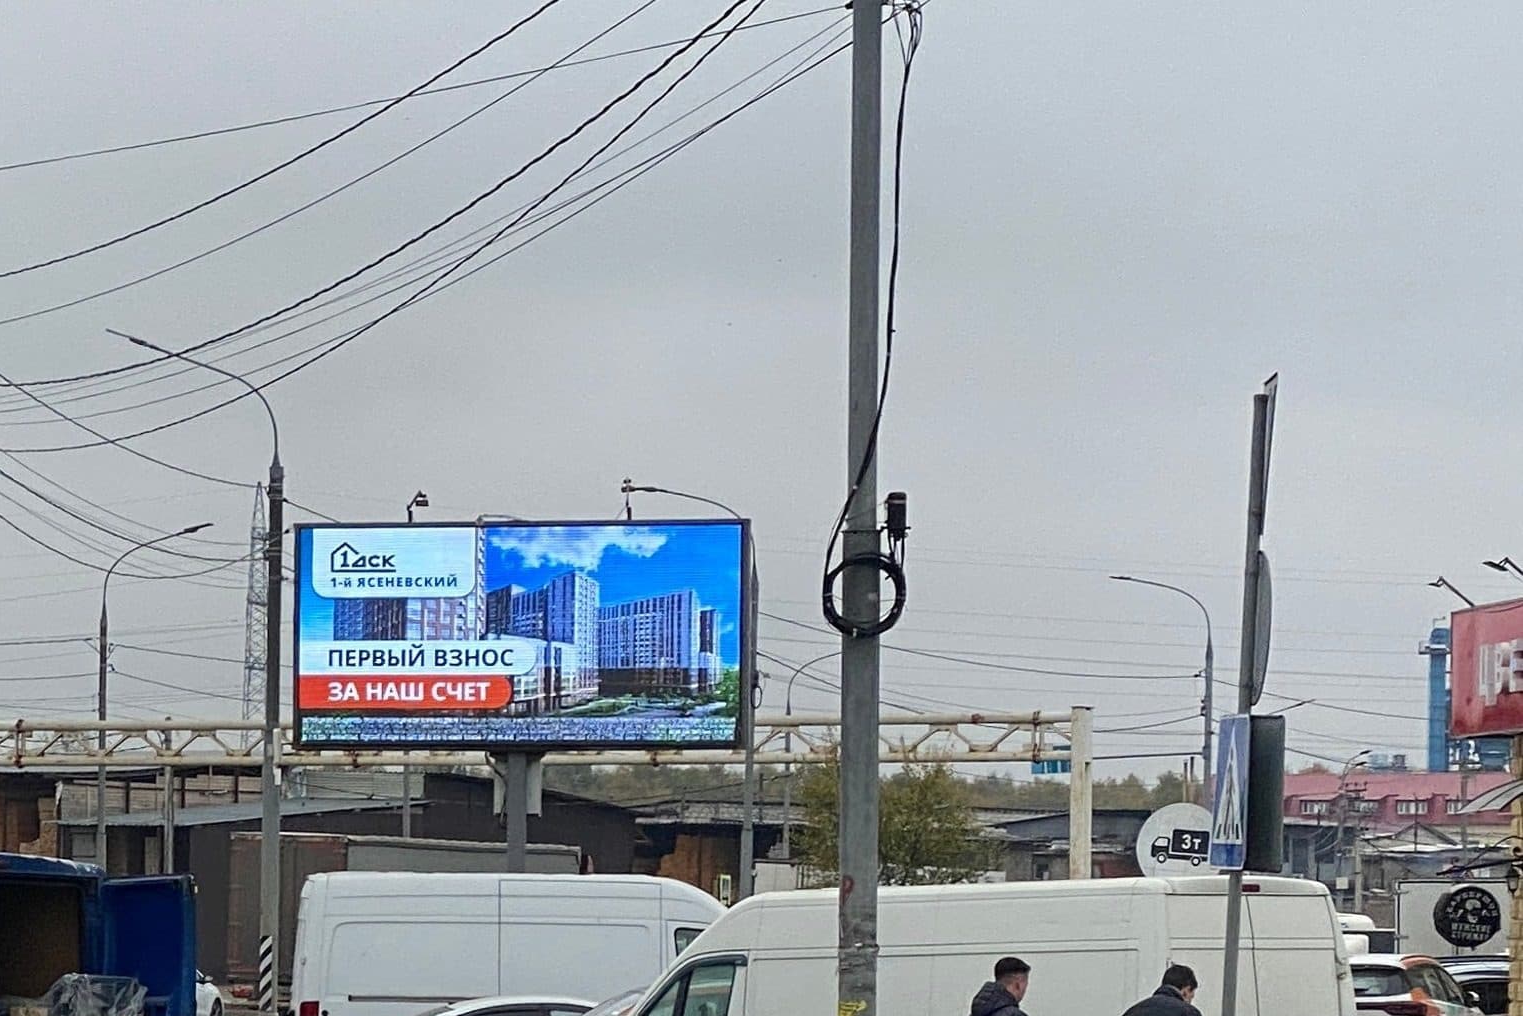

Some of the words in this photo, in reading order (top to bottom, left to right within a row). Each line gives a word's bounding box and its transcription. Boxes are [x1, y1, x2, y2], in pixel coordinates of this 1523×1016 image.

[357, 574, 458, 588] ЯСЕНЕВСКИЙ
[328, 643, 425, 667] ПЕРВЫЙ
[434, 649, 514, 667] ВЗНОС
[328, 682, 360, 701] ЗА
[366, 682, 425, 701] НАШ
[431, 682, 491, 701] СЧЕТ
